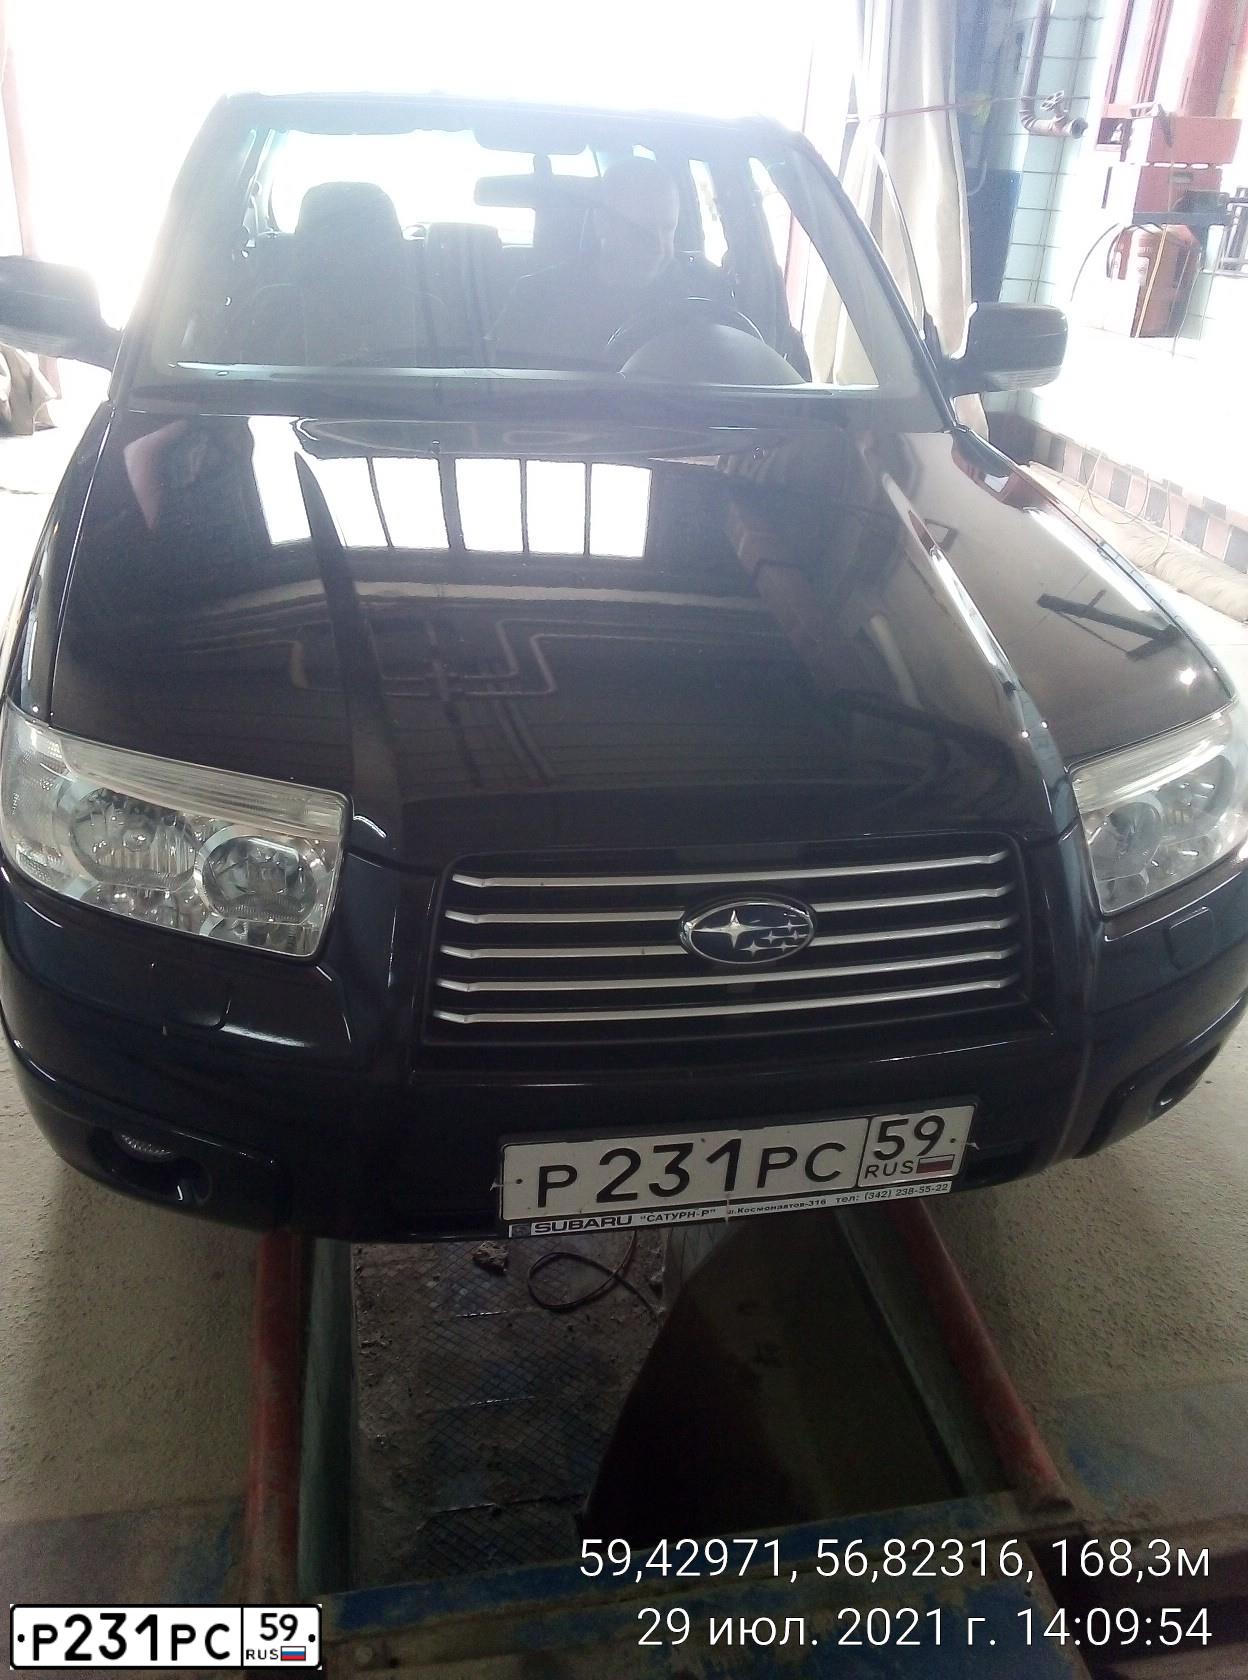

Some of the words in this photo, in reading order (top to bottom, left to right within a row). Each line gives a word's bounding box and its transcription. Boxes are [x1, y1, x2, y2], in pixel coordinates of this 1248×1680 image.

[537, 1138, 846, 1208] Р231РС
[873, 1115, 946, 1161] 59
[864, 1160, 914, 1179] RUS
[864, 1190, 891, 1201] (342)
[896, 1183, 949, 1197] 238-55-22
[534, 1215, 632, 1233] SUBARU
